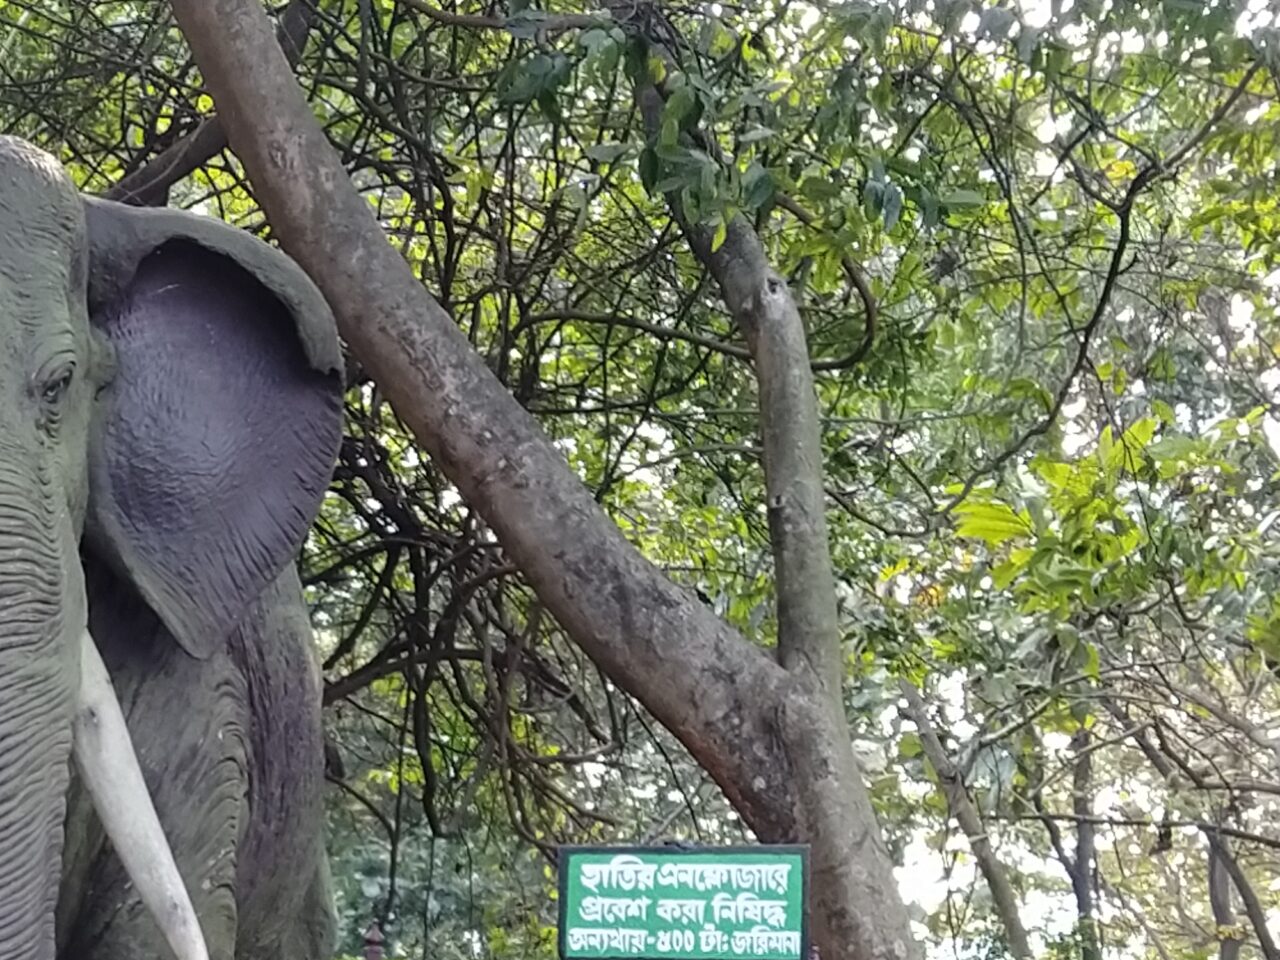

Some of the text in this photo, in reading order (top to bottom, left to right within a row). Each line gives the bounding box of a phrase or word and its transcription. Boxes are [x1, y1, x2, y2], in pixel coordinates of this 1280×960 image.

[580, 854, 657, 893] হাতির
[579, 892, 788, 928] প্রবেশ করা নিষিদ্ধ
[730, 925, 801, 955] জরিমানা
